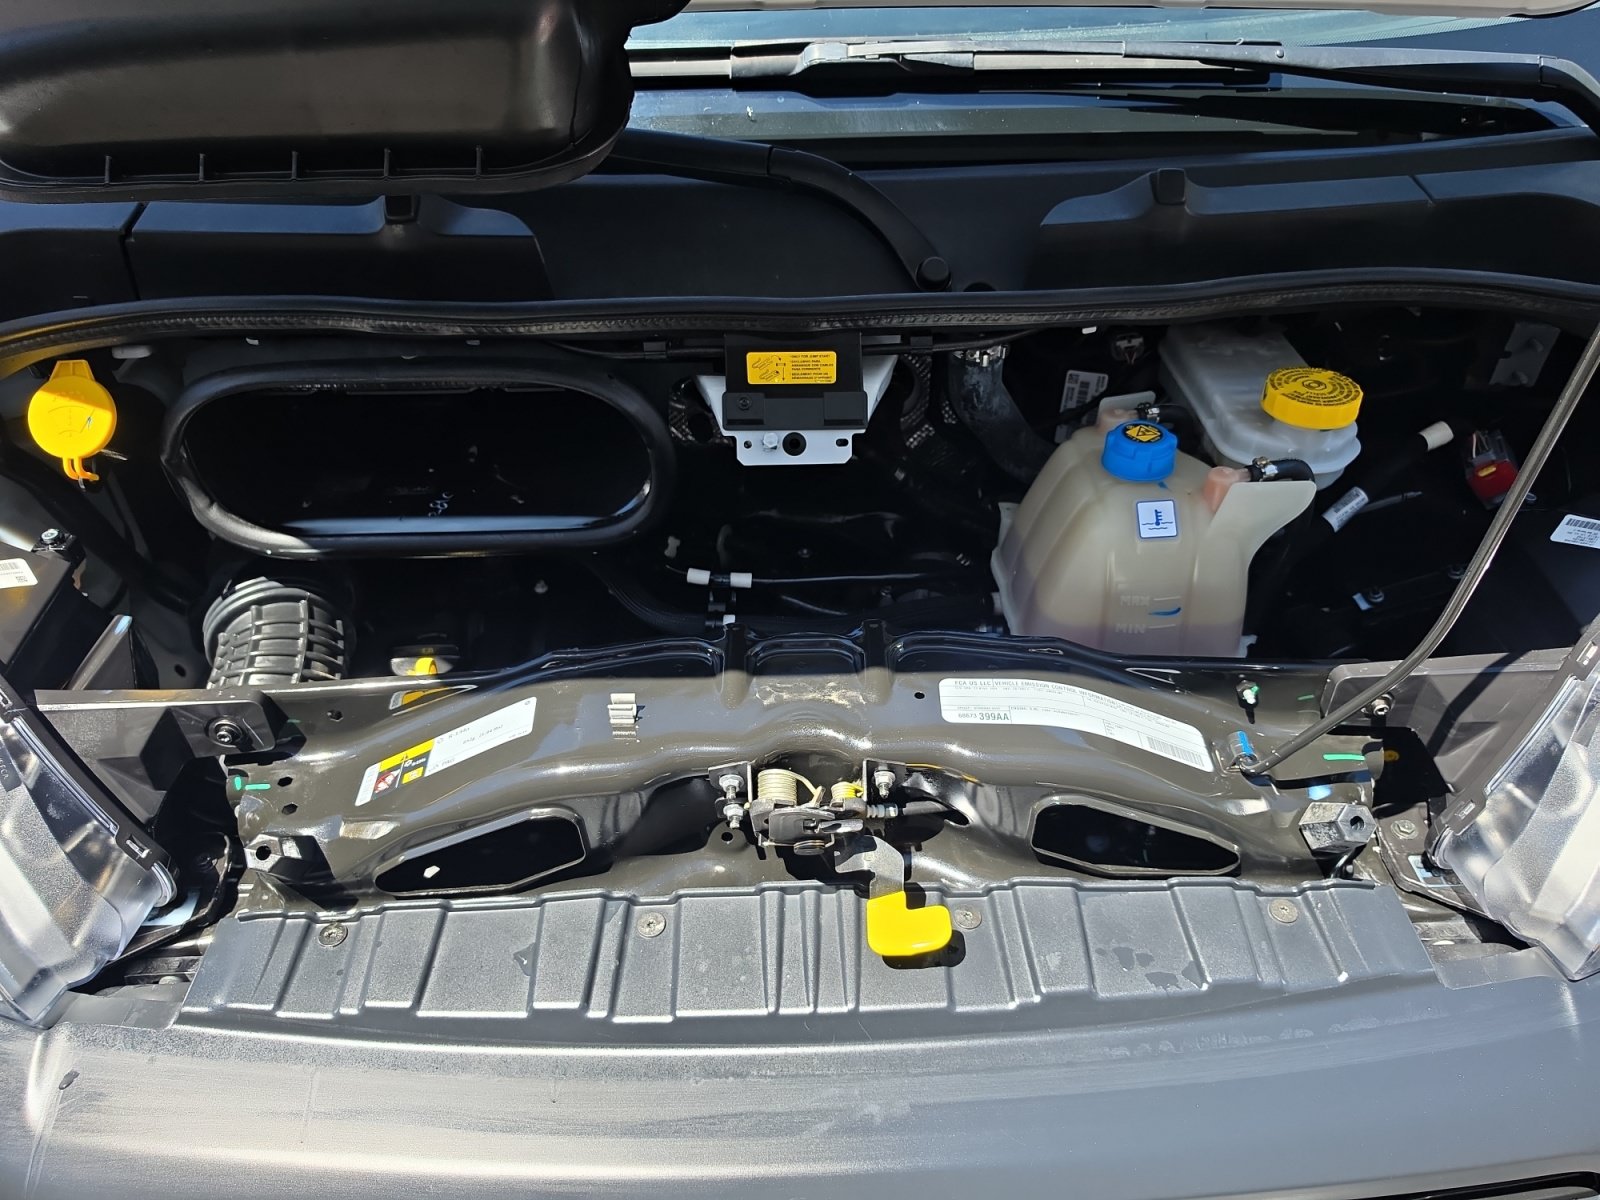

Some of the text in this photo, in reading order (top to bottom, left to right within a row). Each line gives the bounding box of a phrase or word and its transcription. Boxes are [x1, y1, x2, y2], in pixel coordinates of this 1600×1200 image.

[1120, 595, 1150, 606] MAX
[1115, 623, 1146, 634] MIN
[1020, 681, 1050, 689] EMISSION
[979, 712, 1010, 721] 399AA
